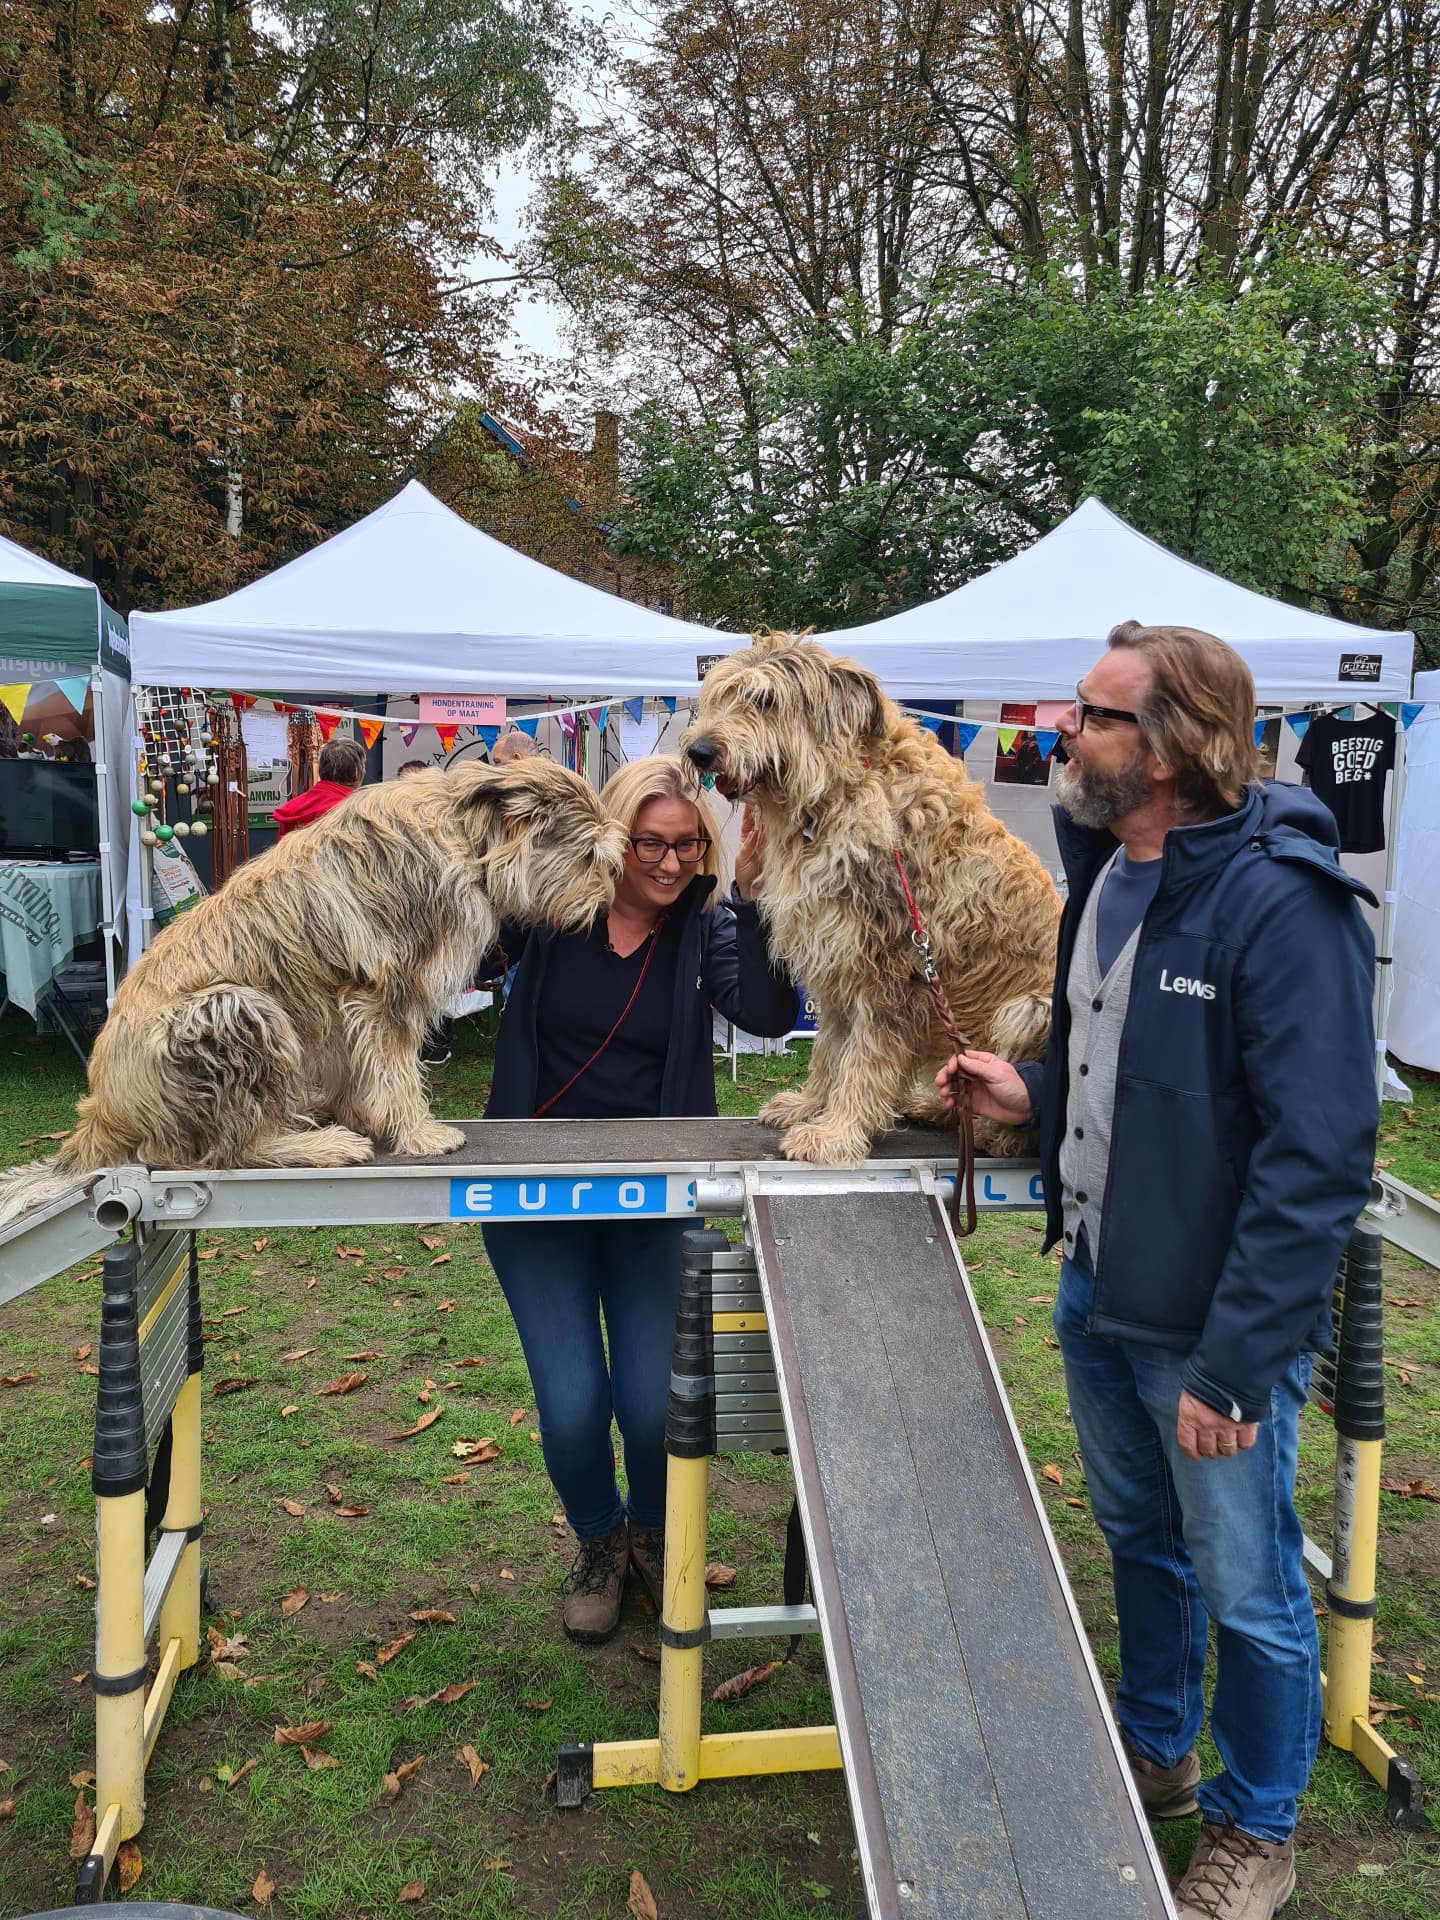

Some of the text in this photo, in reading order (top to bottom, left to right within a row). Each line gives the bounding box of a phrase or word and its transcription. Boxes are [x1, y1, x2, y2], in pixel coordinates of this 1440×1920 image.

[1341, 661, 1380, 674] GRIZZLY
[432, 699, 494, 709] HONDENTRAINING
[447, 709, 480, 718] OP MAAT
[1331, 737, 1384, 755] BEESTIG
[1333, 750, 1376, 772] GOED
[248, 790, 281, 801] ANVRIJ
[1159, 968, 1217, 1000] Lews
